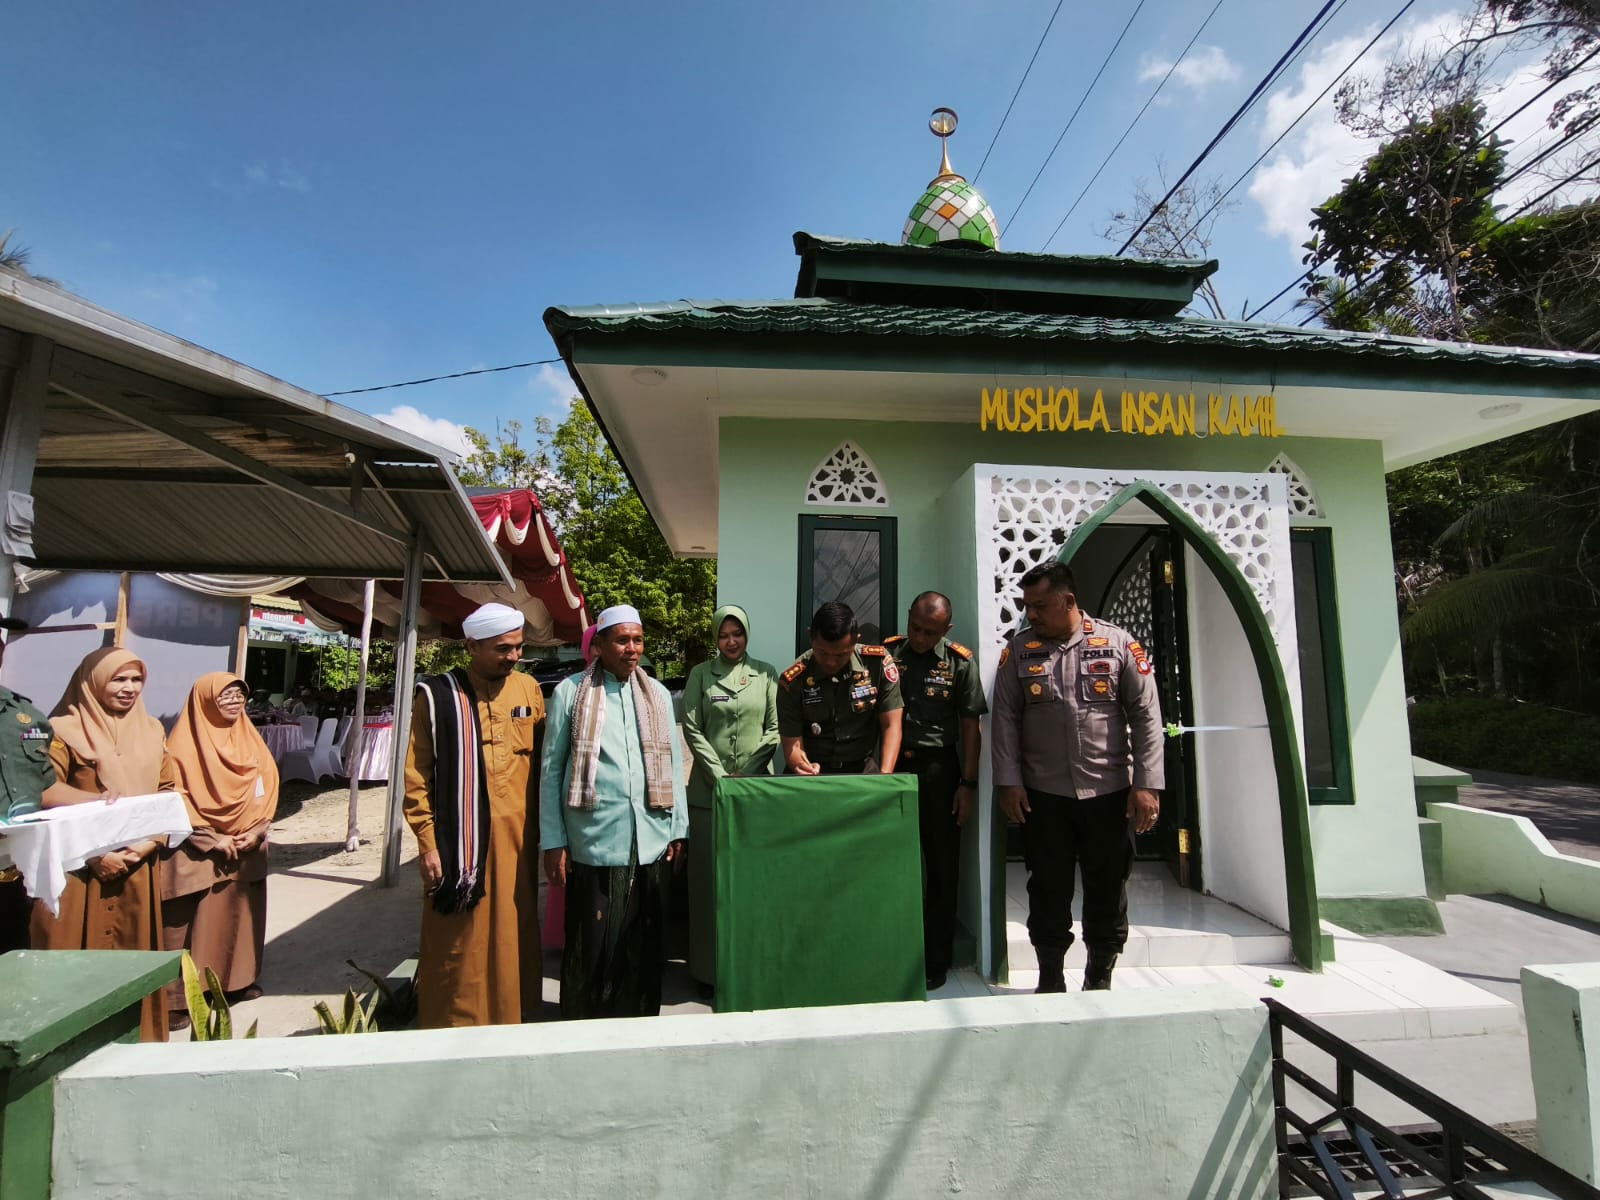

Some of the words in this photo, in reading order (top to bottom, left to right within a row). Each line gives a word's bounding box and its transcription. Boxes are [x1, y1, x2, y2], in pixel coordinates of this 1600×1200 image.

[981, 387, 1111, 432] MUSHOLA
[1121, 391, 1196, 435] INSAN
[1208, 392, 1287, 437] KAMIL
[1083, 649, 1114, 658] POLRI
